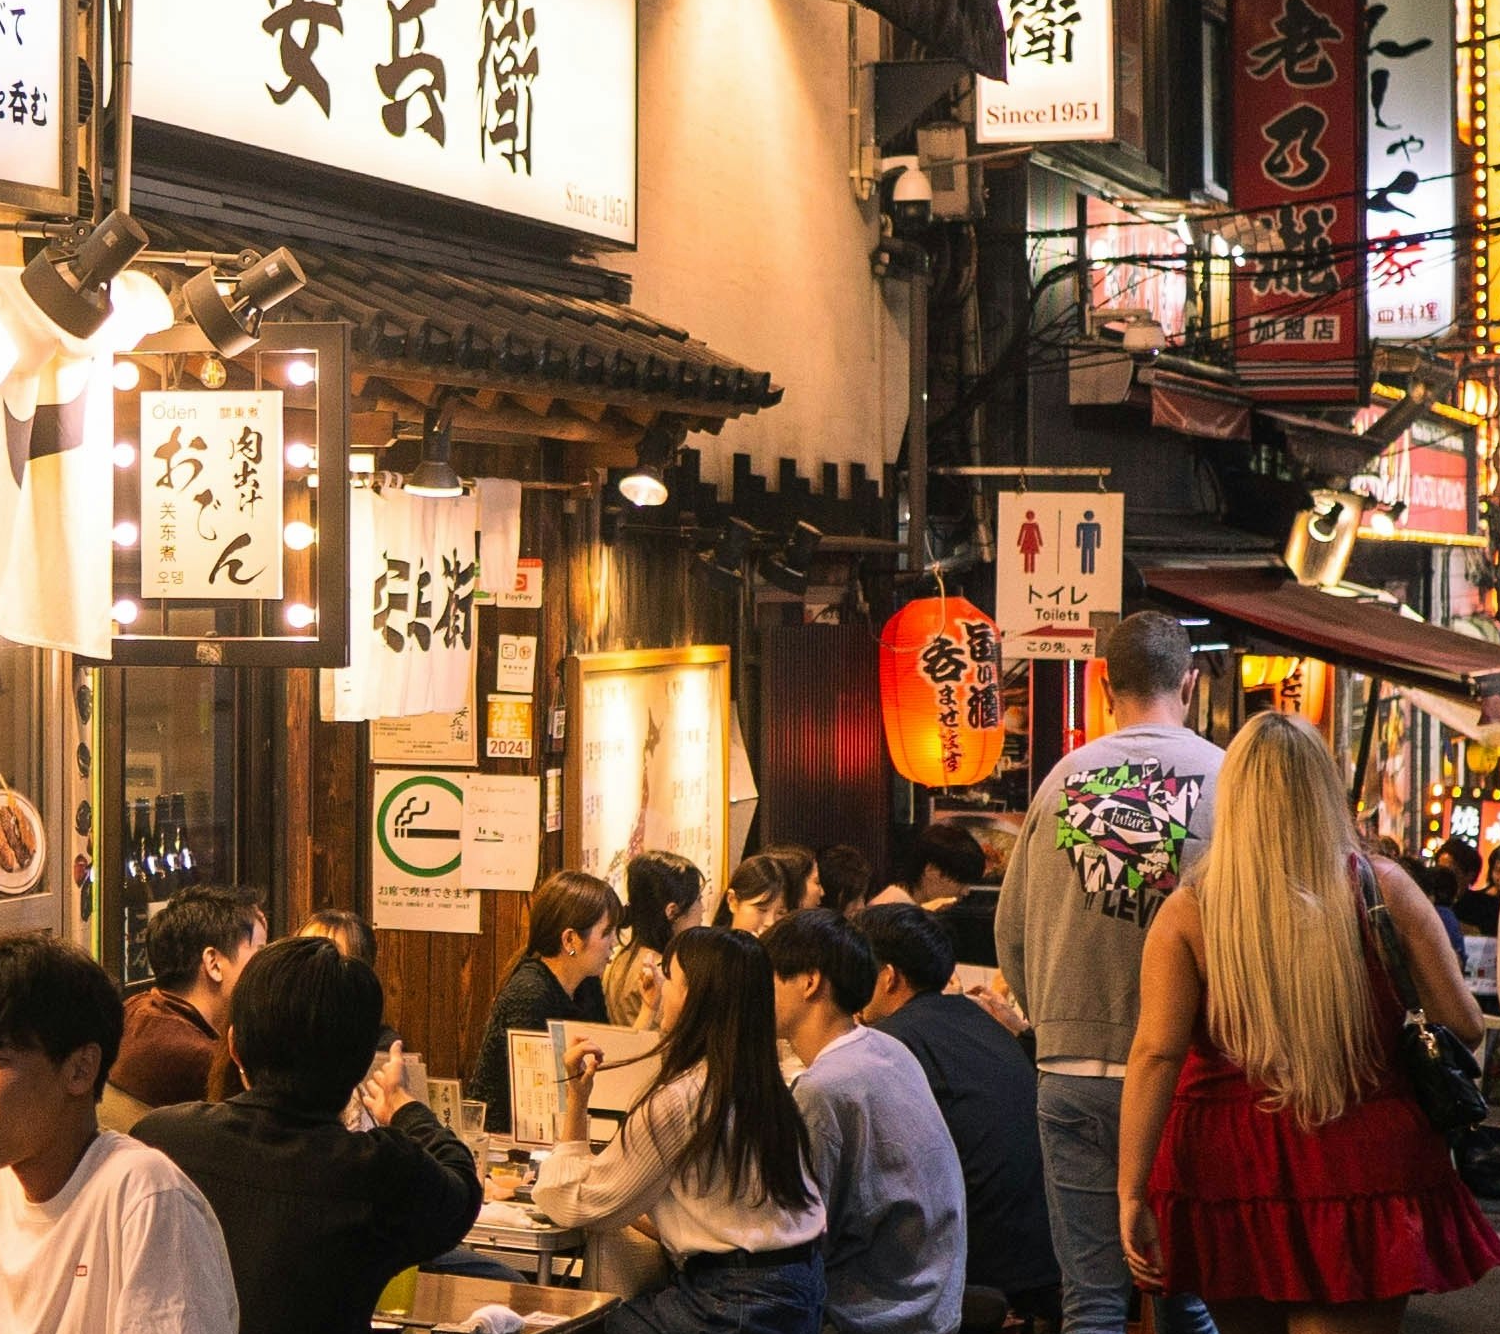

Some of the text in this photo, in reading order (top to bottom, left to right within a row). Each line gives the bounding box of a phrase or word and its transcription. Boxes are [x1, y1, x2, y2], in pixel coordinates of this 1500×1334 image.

[565, 182, 598, 218] Since
[152, 404, 198, 420] Oden
[154, 425, 268, 586] おでん
[159, 502, 178, 564] 关东煮
[156, 571, 185, 586] 오뎅
[1028, 585, 1088, 605] トイレ
[1035, 608, 1080, 622] Toilets
[490, 741, 524, 755] 2024
[1110, 807, 1153, 832] future
